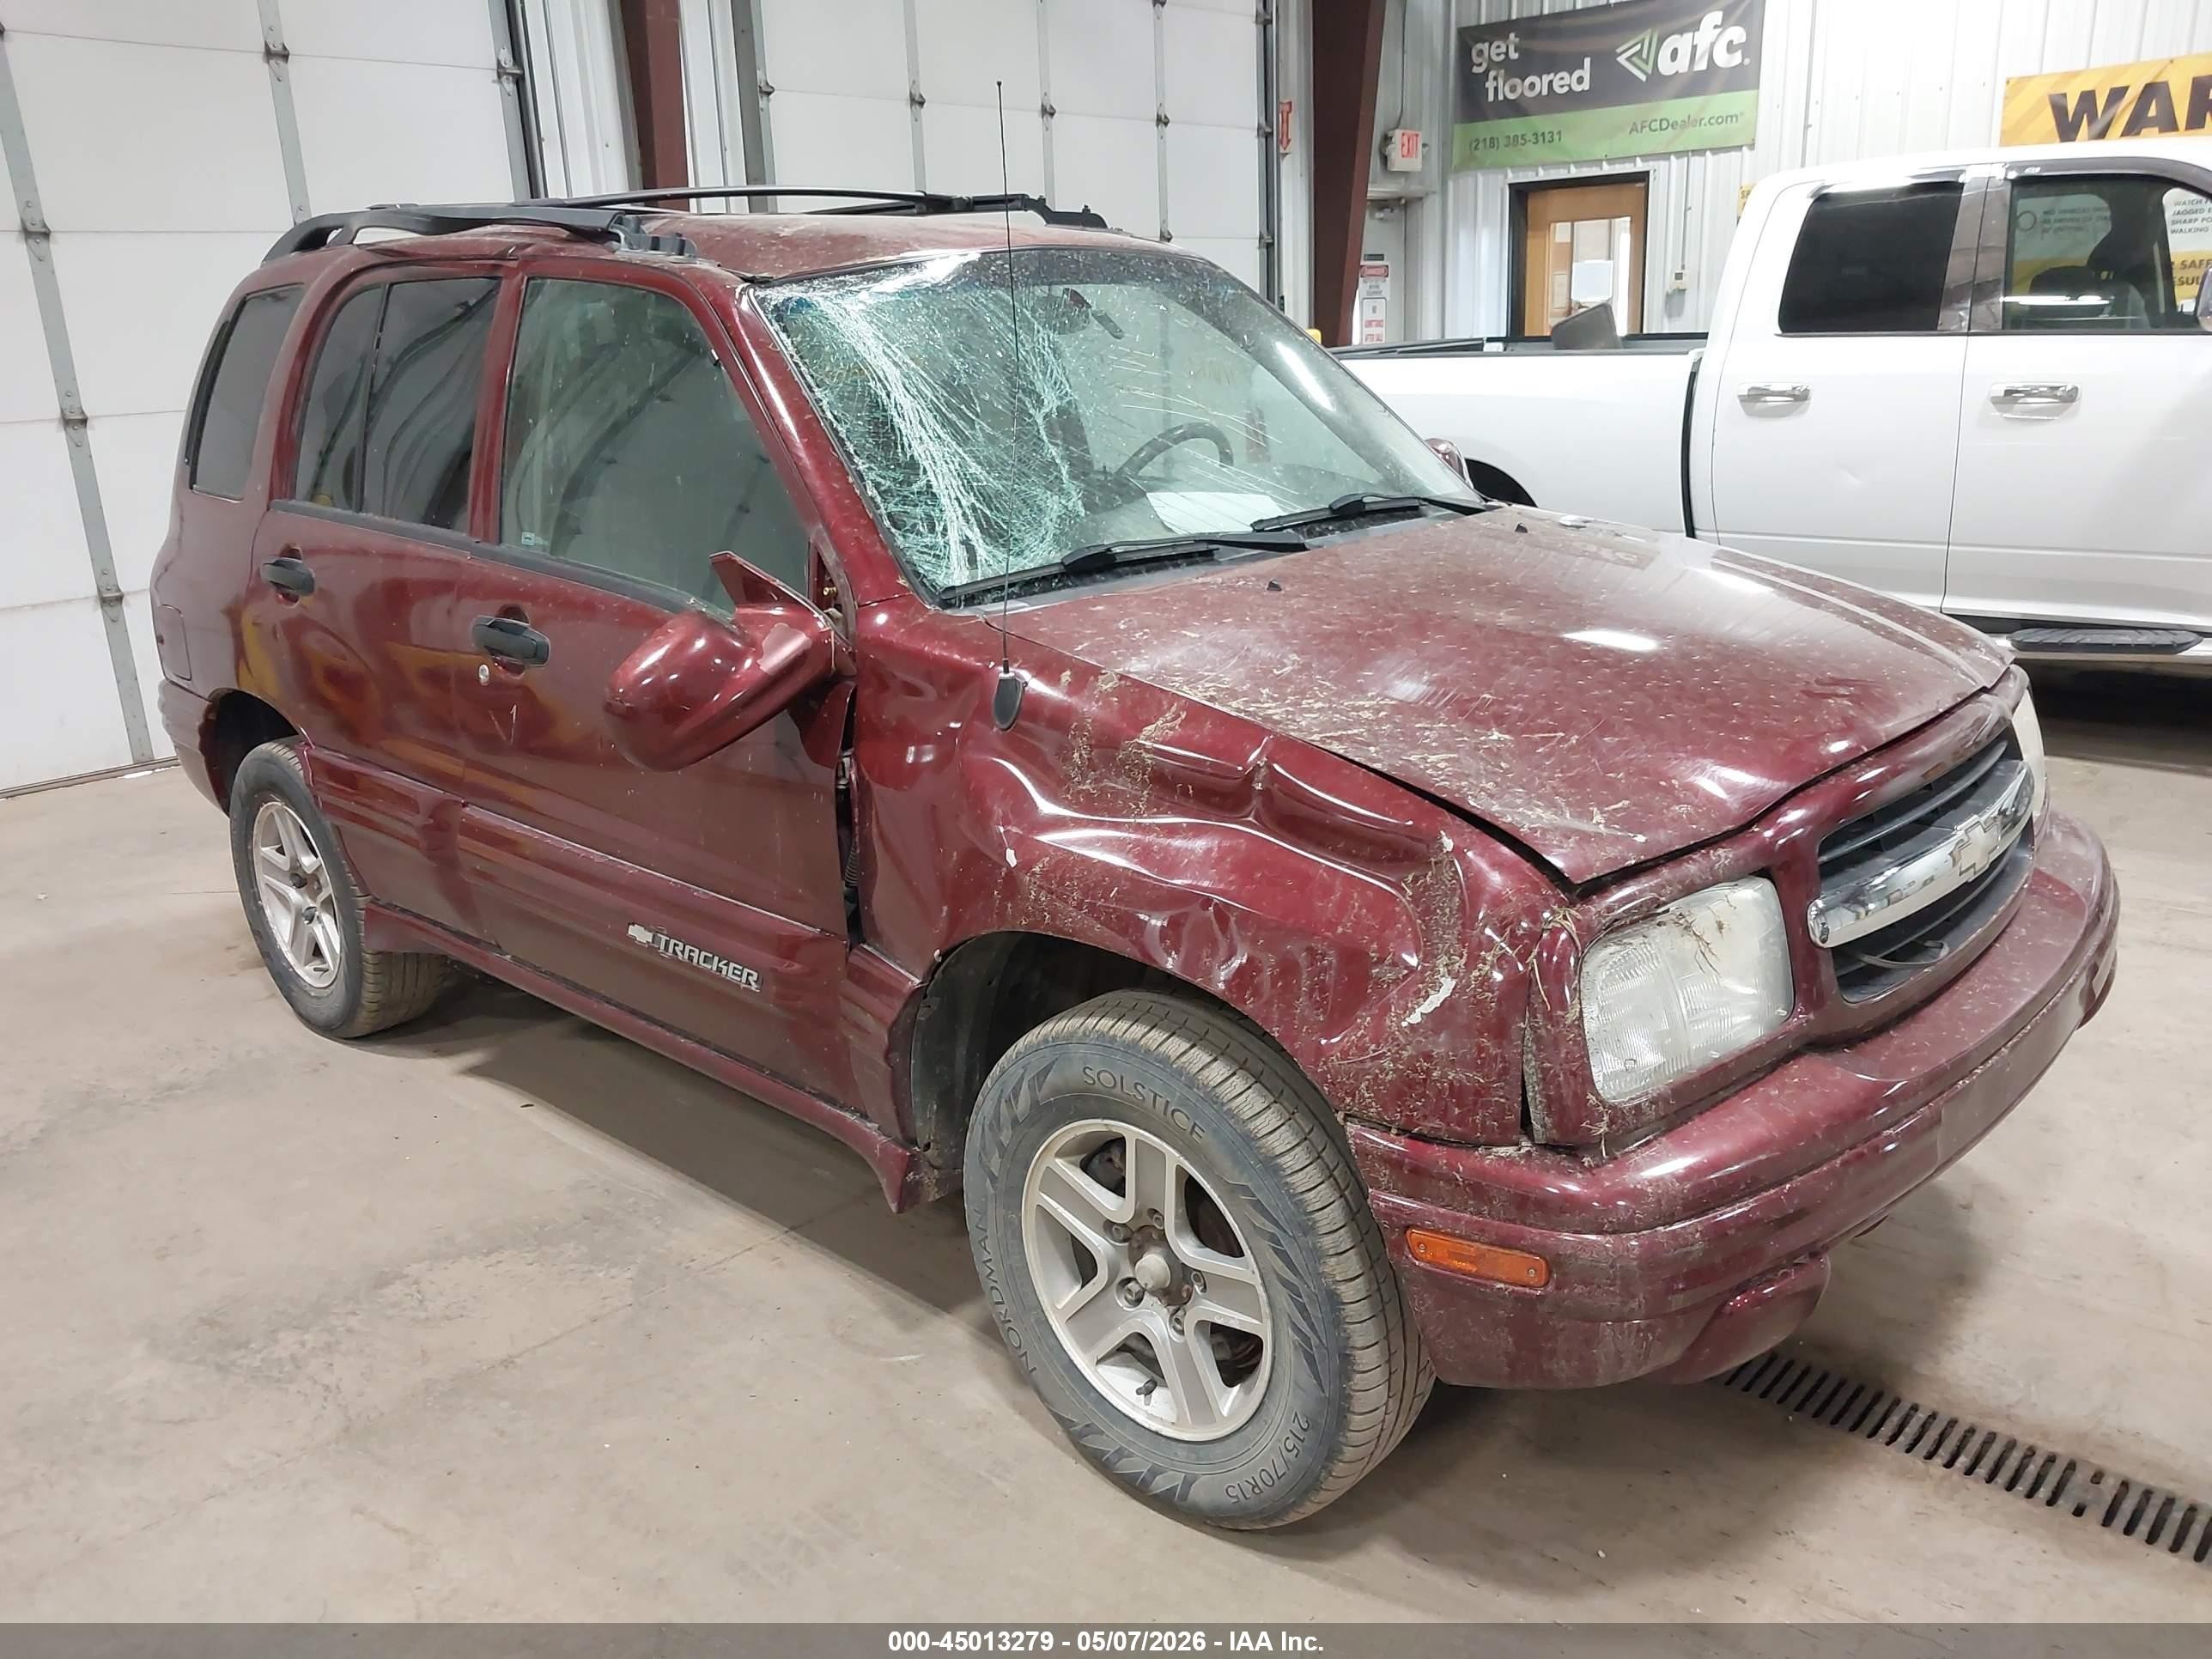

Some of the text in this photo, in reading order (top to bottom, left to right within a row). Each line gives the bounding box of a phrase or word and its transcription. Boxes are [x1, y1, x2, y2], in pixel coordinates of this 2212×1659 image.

[1471, 32, 1520, 74] get
[1485, 57, 1591, 102] floored
[1401, 132, 1419, 158] EXIT
[1469, 137, 1500, 152] (218)
[657, 933, 761, 992] TRACKER
[1082, 1066, 1206, 1143] SOLSTICE
[974, 1208, 1037, 1374] NORDMAN
[1225, 1411, 1310, 1504] 215/70R15
